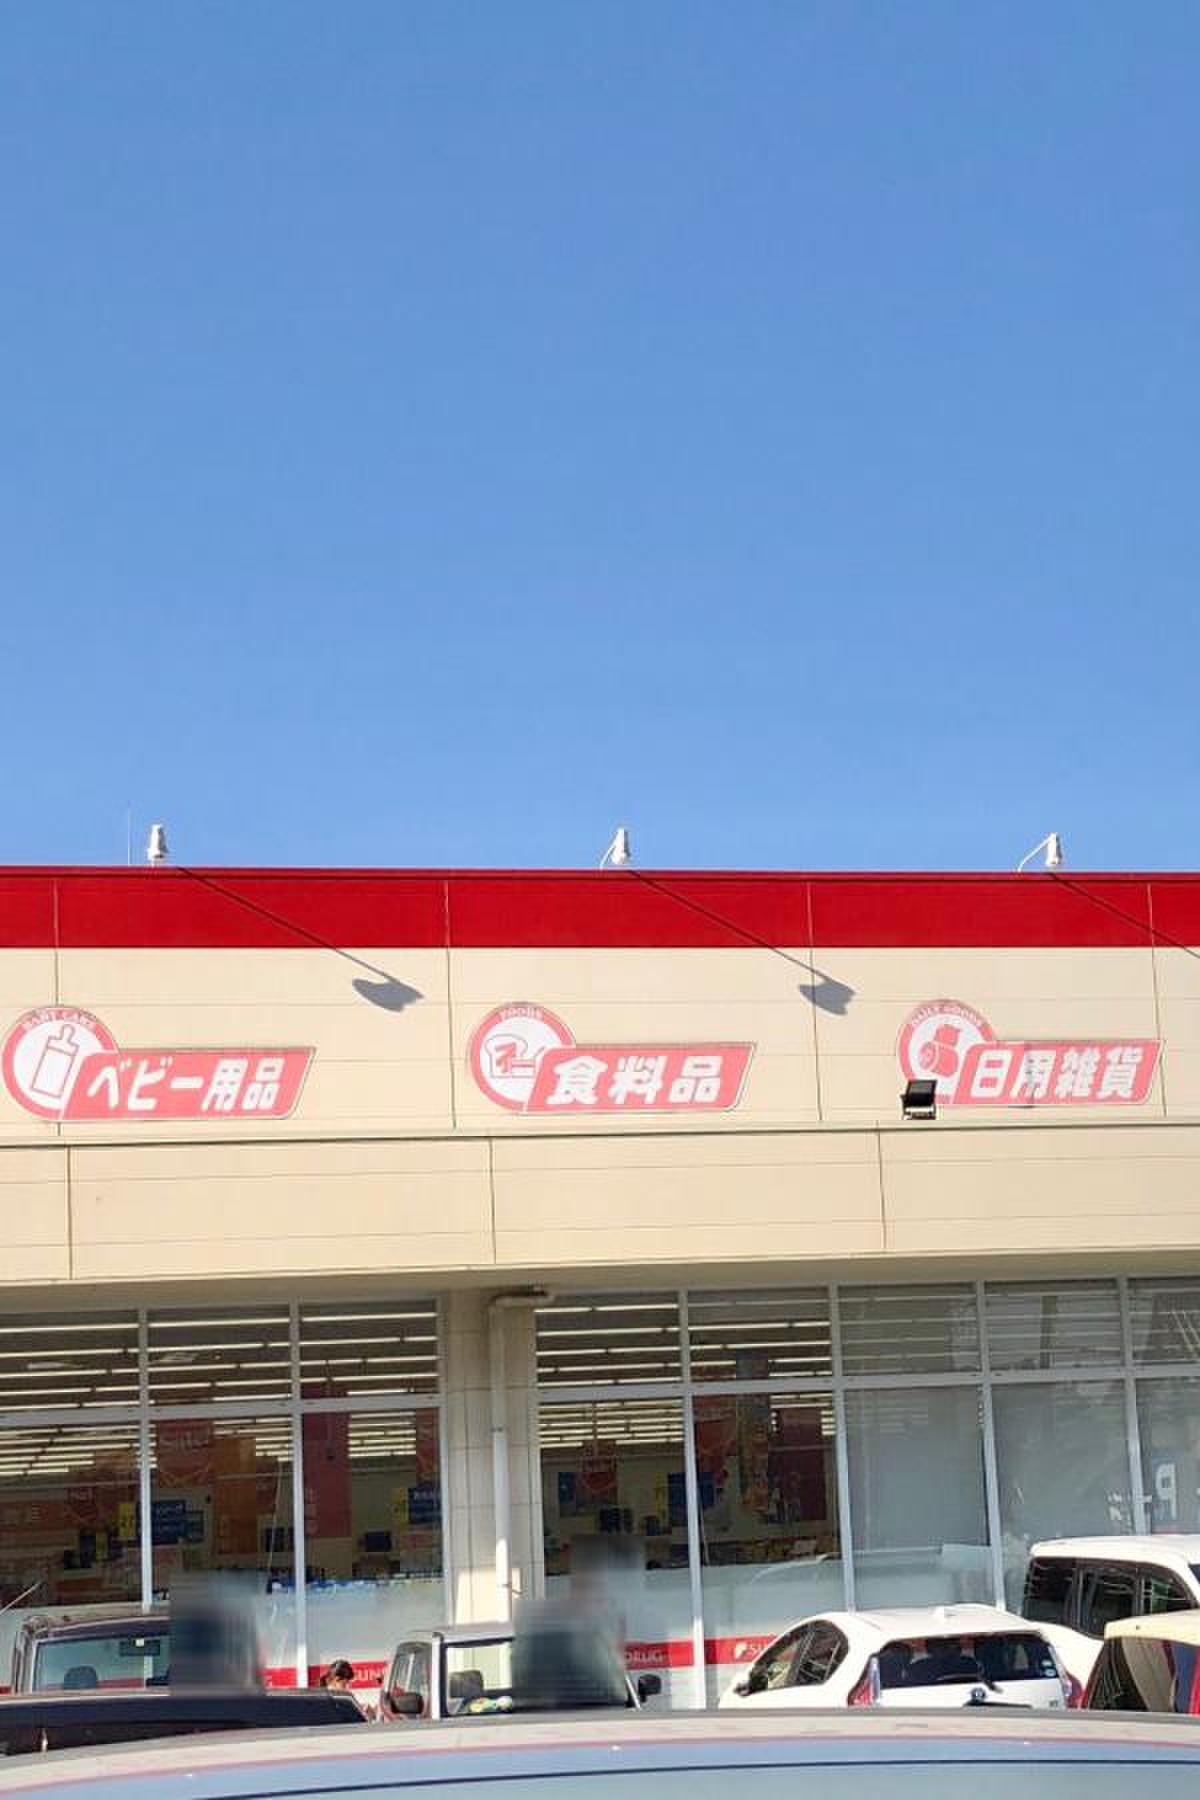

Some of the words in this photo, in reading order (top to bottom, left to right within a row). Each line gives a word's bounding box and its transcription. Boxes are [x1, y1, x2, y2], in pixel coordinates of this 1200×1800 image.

[86, 1056, 285, 1111] ベビー用品
[546, 1056, 724, 1105] 食料品
[970, 1047, 1144, 1099] 日用雑貨
